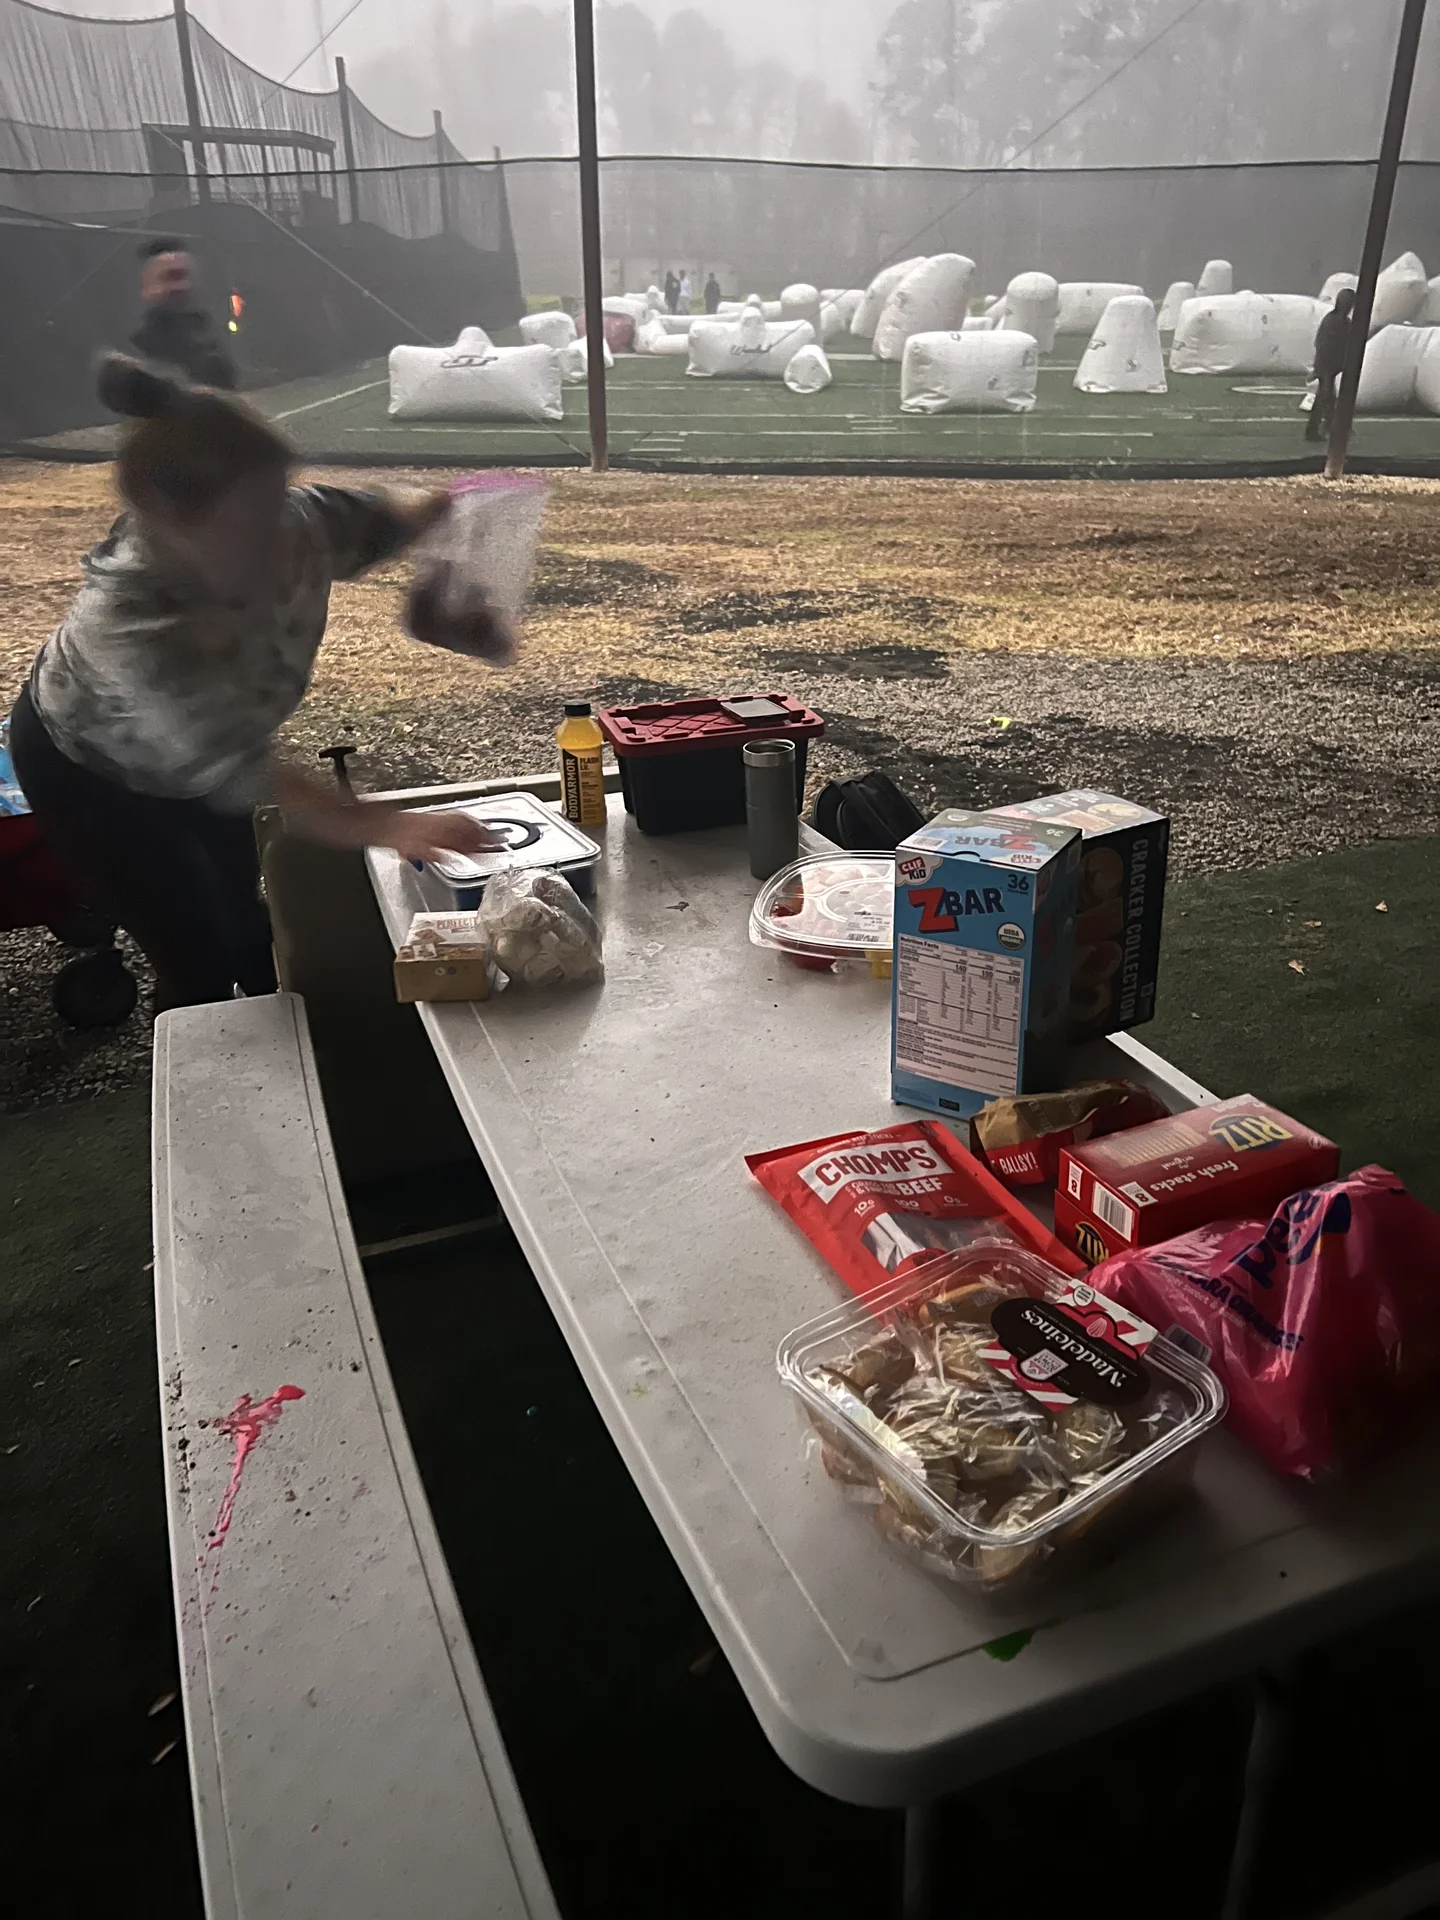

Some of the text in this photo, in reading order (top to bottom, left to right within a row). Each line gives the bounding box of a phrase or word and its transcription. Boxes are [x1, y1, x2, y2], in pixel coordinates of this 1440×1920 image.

[565, 758, 579, 819] BODYARMOR
[1046, 828, 1066, 837] 36
[900, 858, 923, 873] CLIF
[1007, 873, 1030, 892] 36
[1119, 838, 1149, 1023] CRACKER COLLECTION
[1208, 1115, 1294, 1153] RITZ
[814, 1146, 938, 1187] CHOMPS
[999, 1151, 1039, 1175] BALLSY!
[1196, 1159, 1240, 1179] fresh
[896, 1176, 944, 1196] BEEF
[1070, 1179, 1079, 1194] 8
[1149, 1172, 1197, 1193] stacks
[1134, 1192, 1150, 1204] 8
[1075, 1223, 1110, 1266] RITZ
[1183, 1284, 1210, 1305] sweet
[1020, 1308, 1128, 1389] Madeleines
